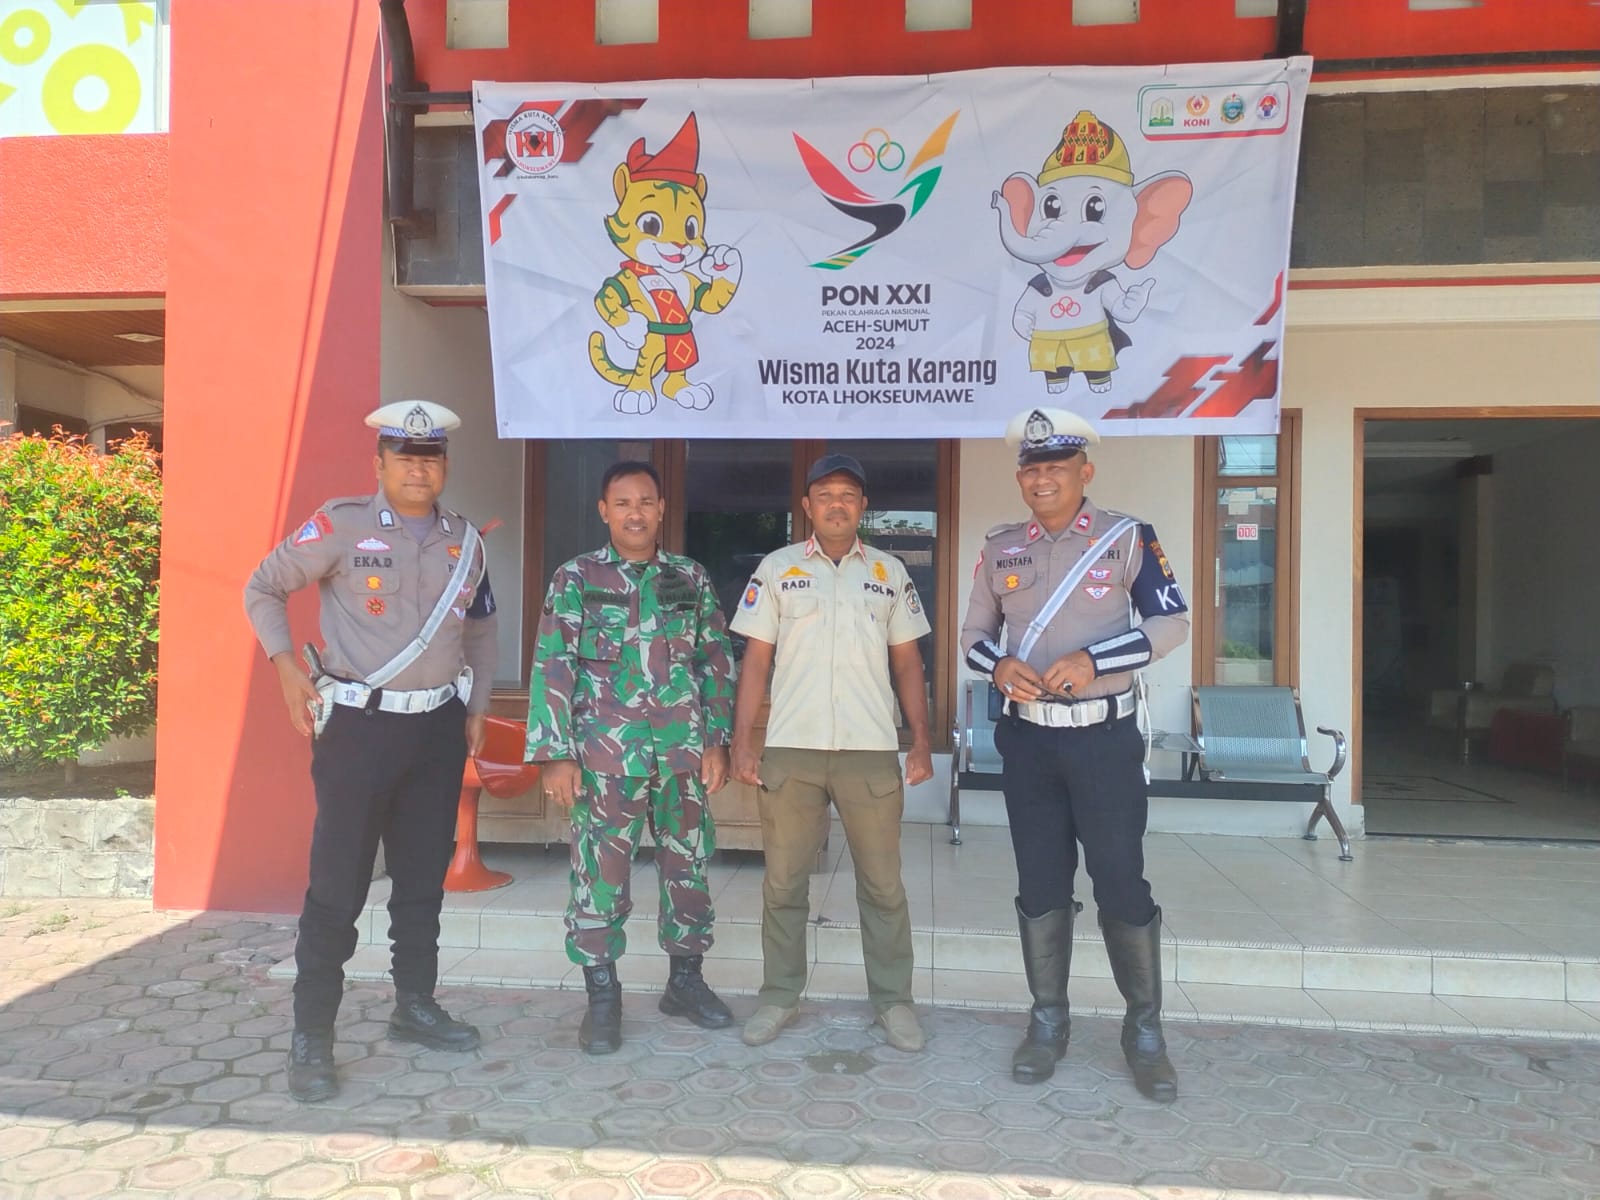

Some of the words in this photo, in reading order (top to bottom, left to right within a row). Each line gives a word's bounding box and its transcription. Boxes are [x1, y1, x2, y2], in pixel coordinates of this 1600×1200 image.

[1183, 119, 1210, 127] KONI
[821, 285, 879, 306] PON
[885, 283, 931, 305] XXI
[891, 307, 931, 315] NASIONAL
[822, 318, 930, 333] ACEH-SUMUT
[855, 337, 896, 350] 2024
[758, 359, 839, 385] Wisma
[846, 358, 901, 384] Kuta
[908, 357, 997, 386] Karang
[782, 390, 832, 404] KOTA
[834, 388, 974, 404] LHOKSEUMAWE
[996, 556, 1033, 569] MUSTAFA
[781, 580, 811, 592] RADI
[863, 582, 885, 595] POL
